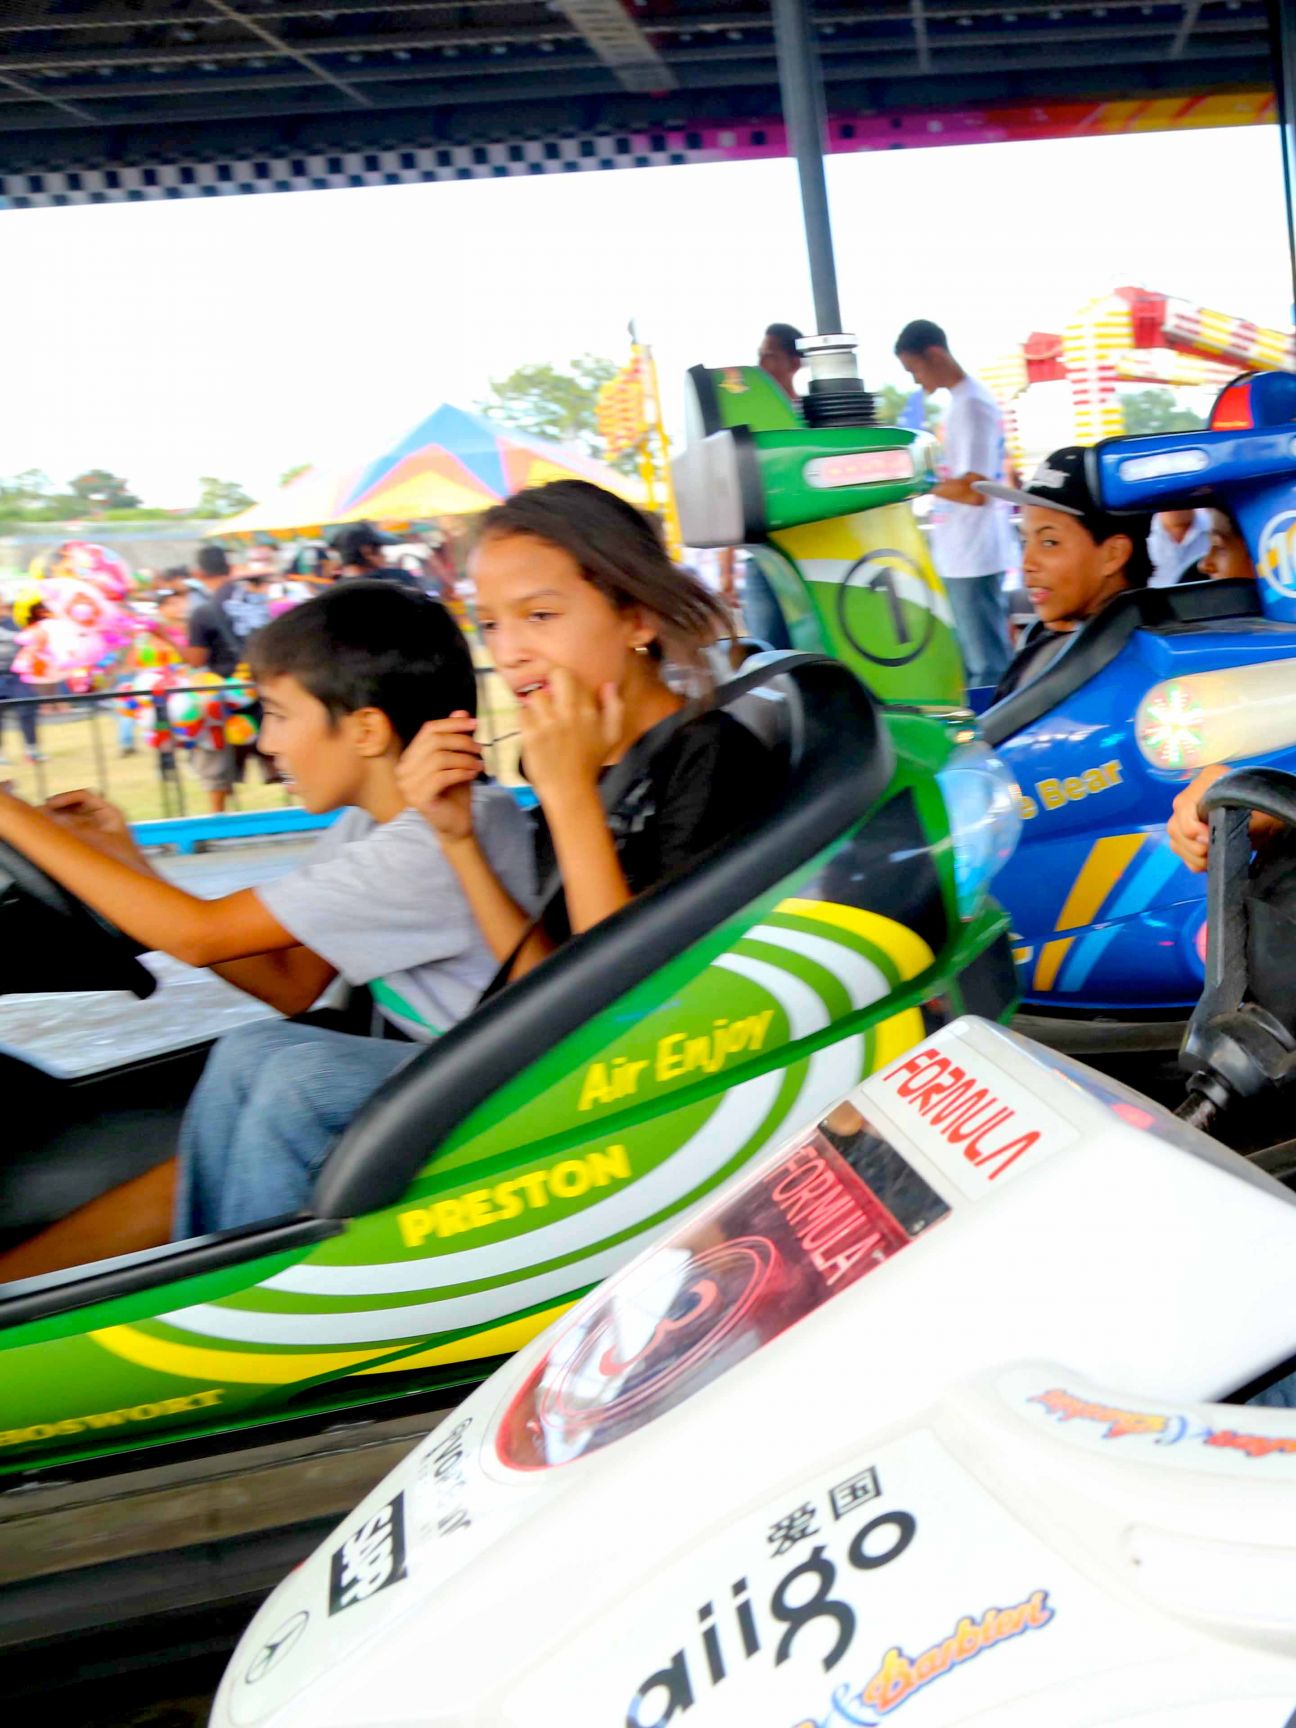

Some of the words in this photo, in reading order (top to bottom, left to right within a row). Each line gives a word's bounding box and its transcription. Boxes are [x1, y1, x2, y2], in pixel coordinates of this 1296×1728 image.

[866, 567, 912, 645] 1
[1034, 759, 1124, 811] Bear
[577, 1057, 649, 1111] Air
[655, 1010, 775, 1082] Enjoy
[882, 1048, 1041, 1181] FORMULA
[397, 1144, 632, 1247] PRESTON
[763, 1146, 882, 1286] FORMULA
[767, 1466, 882, 1558] 爱国
[626, 1511, 917, 1728] aiigo
